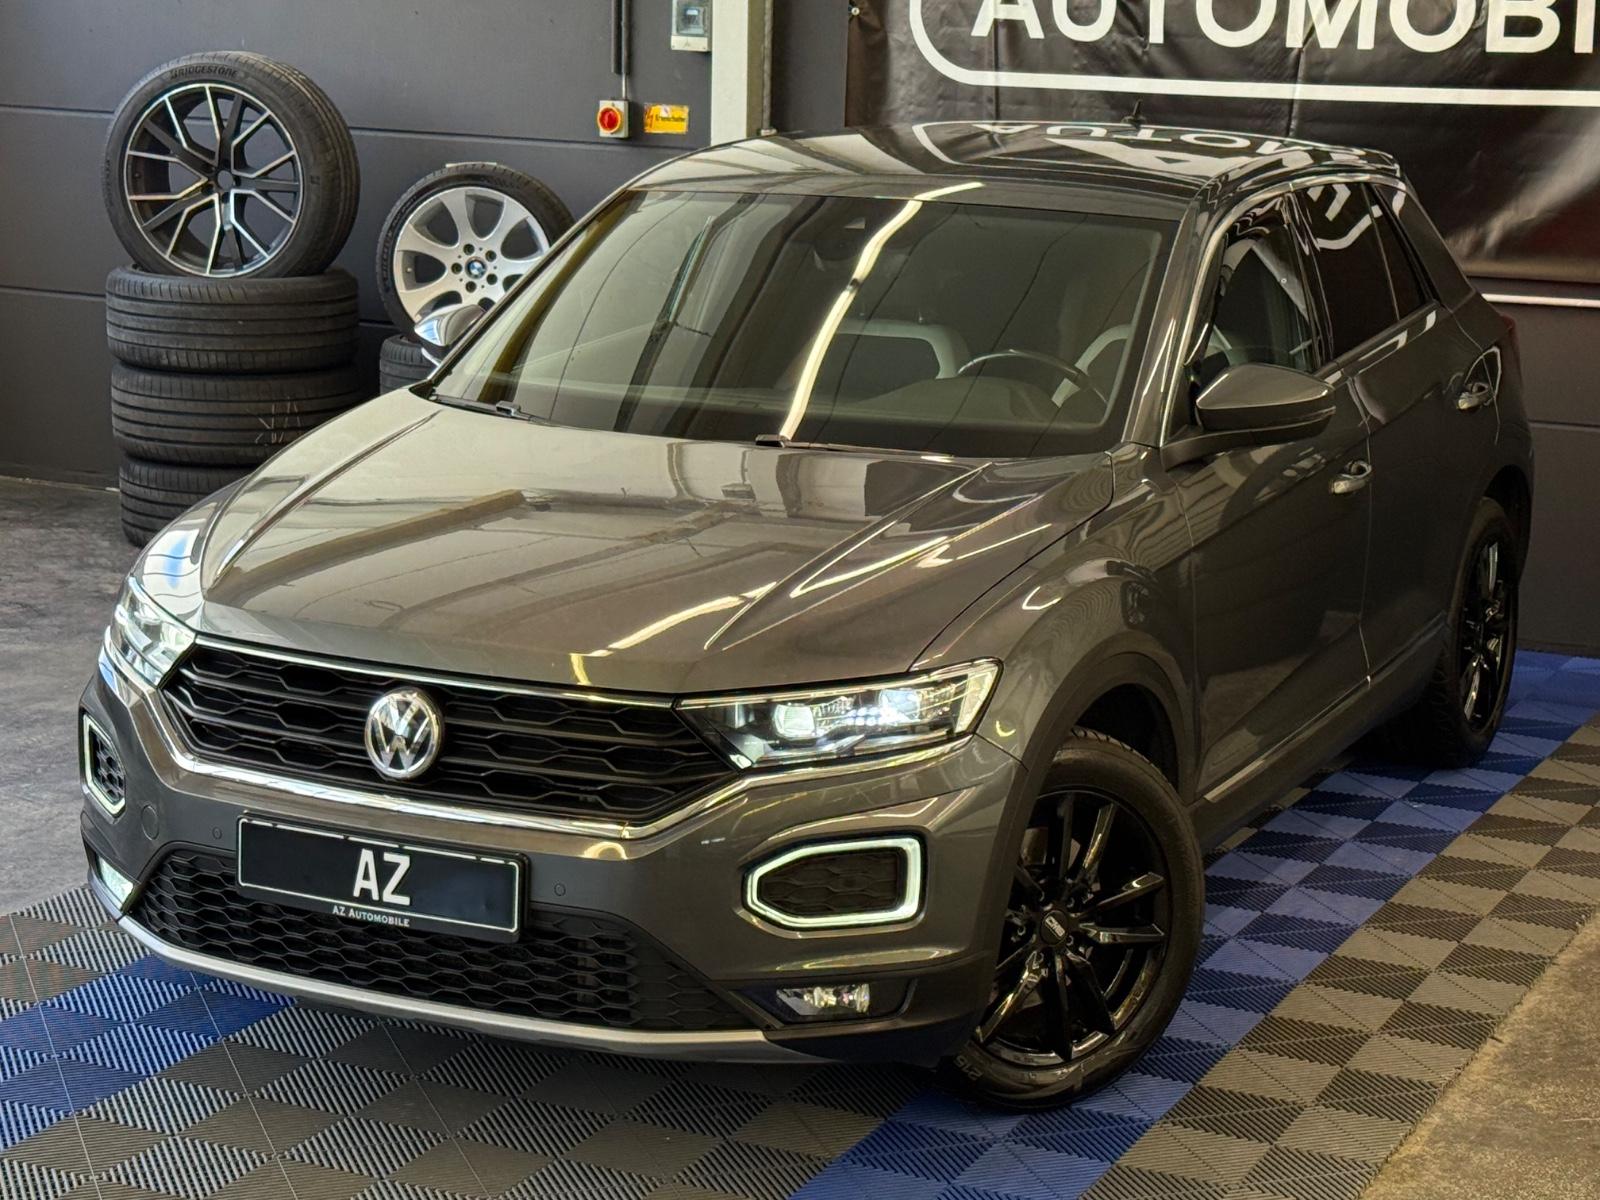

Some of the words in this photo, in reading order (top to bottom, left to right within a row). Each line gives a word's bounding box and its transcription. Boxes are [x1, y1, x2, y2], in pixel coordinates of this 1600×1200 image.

[352, 847, 412, 906] AZ
[332, 904, 346, 917] AZ
[348, 908, 411, 926] AUTOMOBILE
